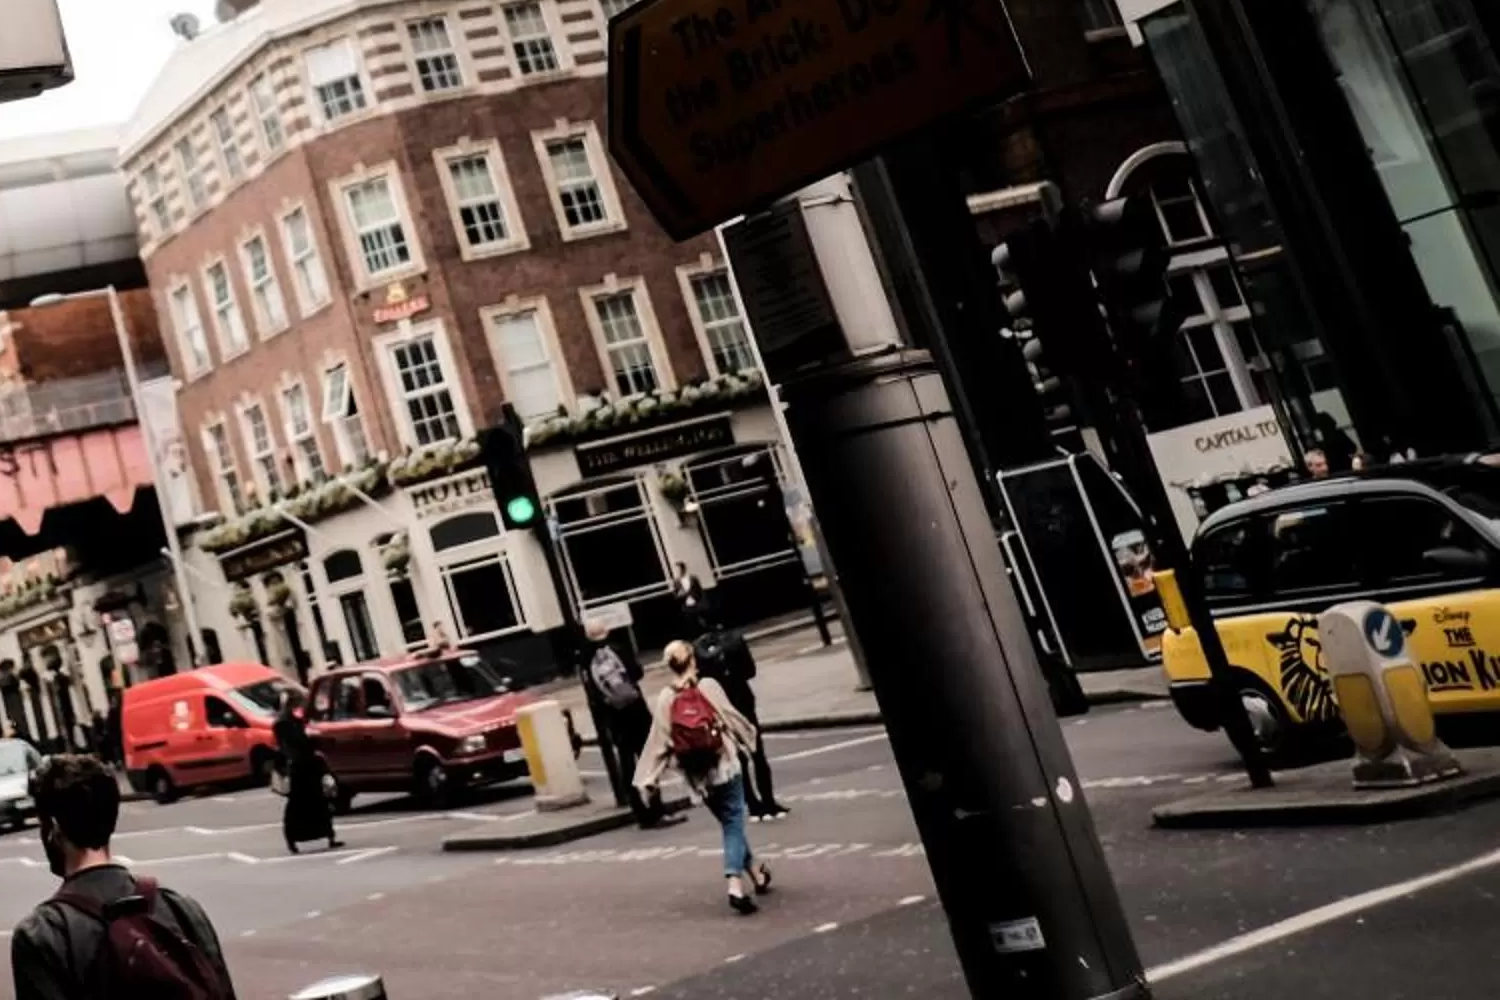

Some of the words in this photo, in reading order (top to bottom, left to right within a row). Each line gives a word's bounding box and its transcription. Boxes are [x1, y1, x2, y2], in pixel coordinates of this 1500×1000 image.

[672, 6, 736, 59] The
[664, 77, 720, 126] the
[724, 19, 833, 93] Brick:
[689, 42, 918, 171] Superheroes
[1195, 426, 1257, 452] CAPITAL
[1443, 627, 1476, 646] THE
[1420, 660, 1472, 686] ION
